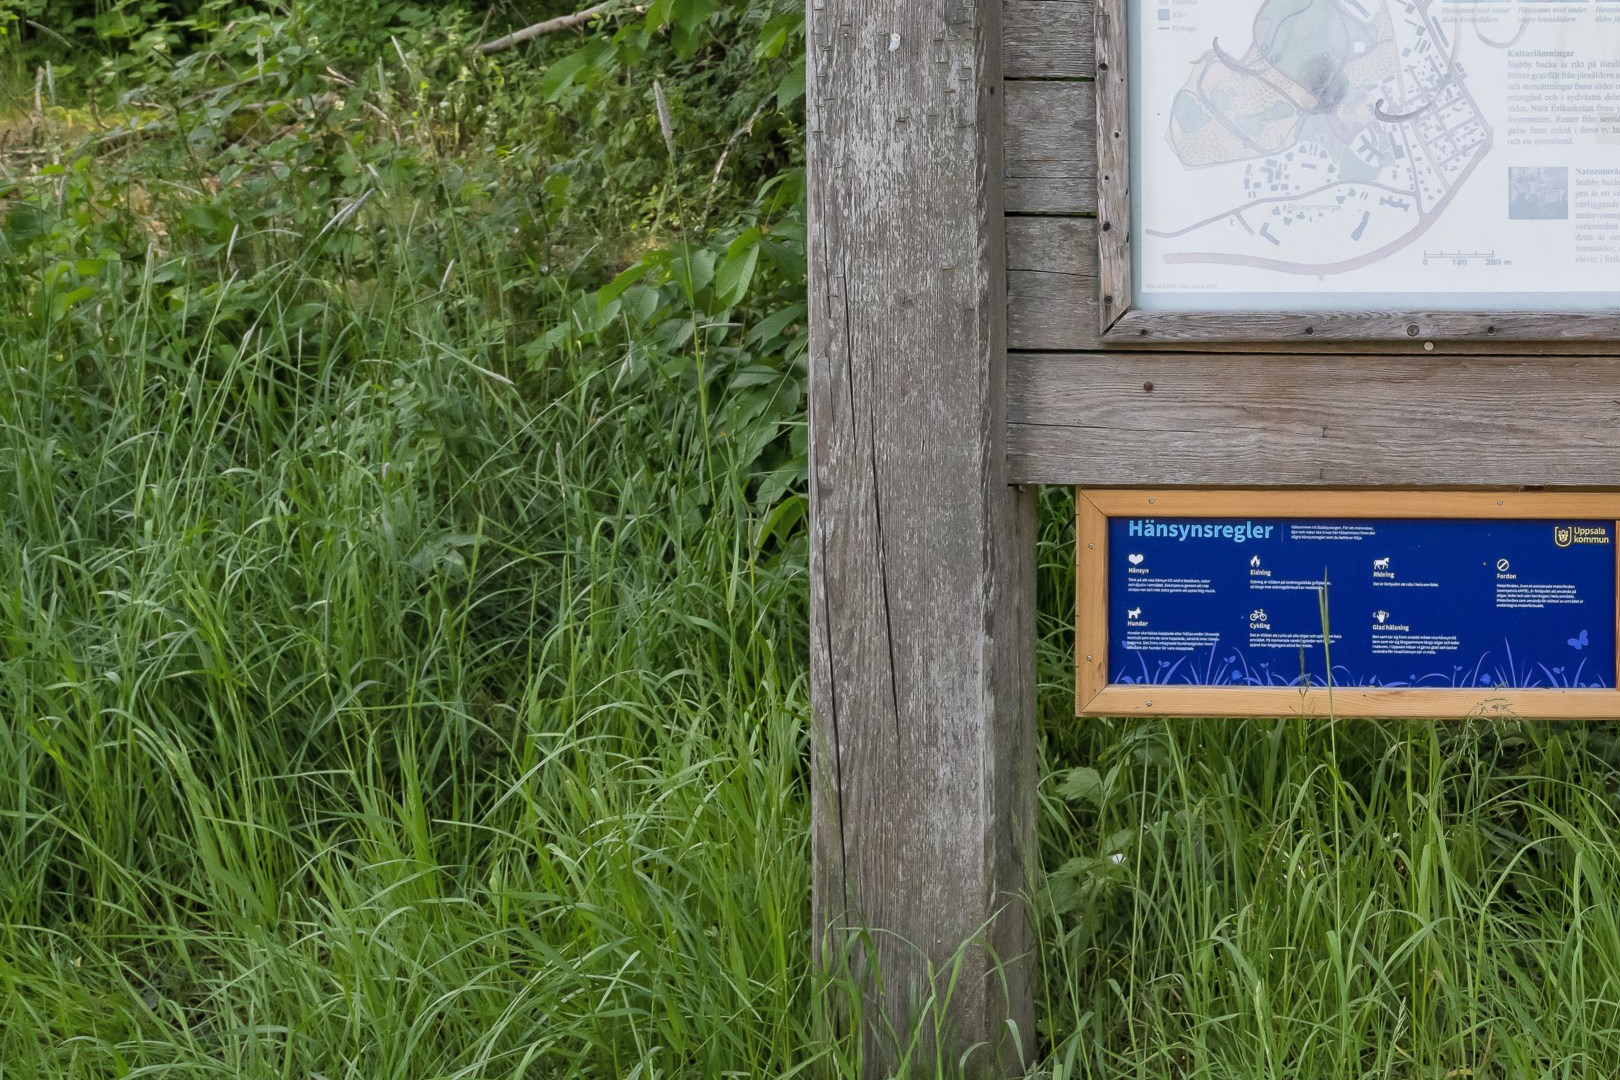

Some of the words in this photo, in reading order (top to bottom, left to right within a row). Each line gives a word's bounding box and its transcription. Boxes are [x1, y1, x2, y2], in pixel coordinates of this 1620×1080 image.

[1128, 519, 1274, 543] Hänsynsregler
[1574, 527, 1606, 537] Uppsala
[1574, 535, 1610, 544] kommun
[1128, 567, 1149, 575] Hänsyn
[1250, 569, 1271, 577] Eldning
[1373, 571, 1395, 579] Ridning
[1249, 622, 1271, 630] Cykling
[1386, 624, 1409, 632] hälsning
